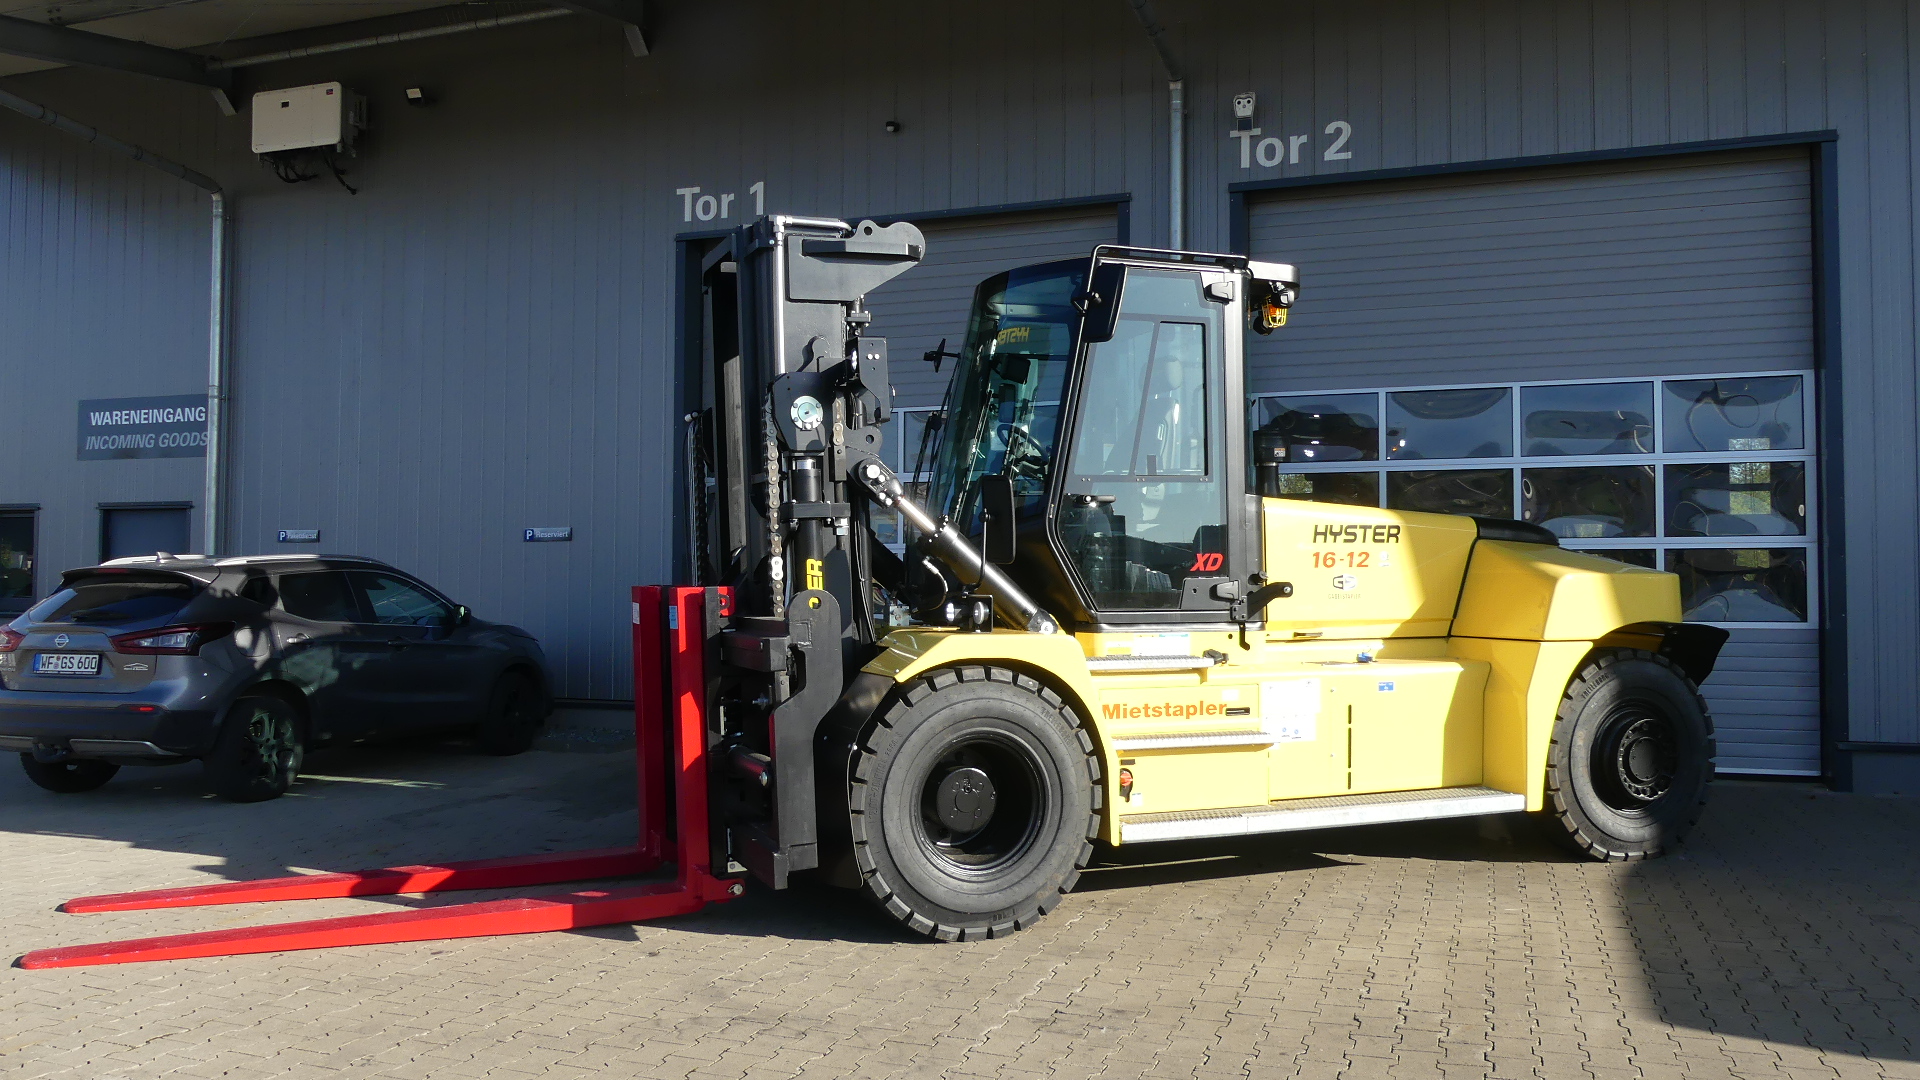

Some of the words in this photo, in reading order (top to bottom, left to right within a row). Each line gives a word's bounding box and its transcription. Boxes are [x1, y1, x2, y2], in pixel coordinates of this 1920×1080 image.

[1230, 127, 1308, 169] Tor
[1324, 120, 1352, 161] 2
[676, 186, 735, 222] Tor
[749, 181, 764, 216] 1
[90, 406, 206, 426] WARENEINGANG
[85, 434, 156, 450] INCOMING
[158, 431, 208, 448] GOODS
[1313, 524, 1401, 543] HYSTER
[1190, 552, 1225, 571] XD
[1312, 551, 1370, 568] 16-12
[41, 655, 56, 670] WF
[60, 655, 75, 670] GS
[77, 655, 98, 670] 600
[1101, 700, 1228, 720] Mietstapler
